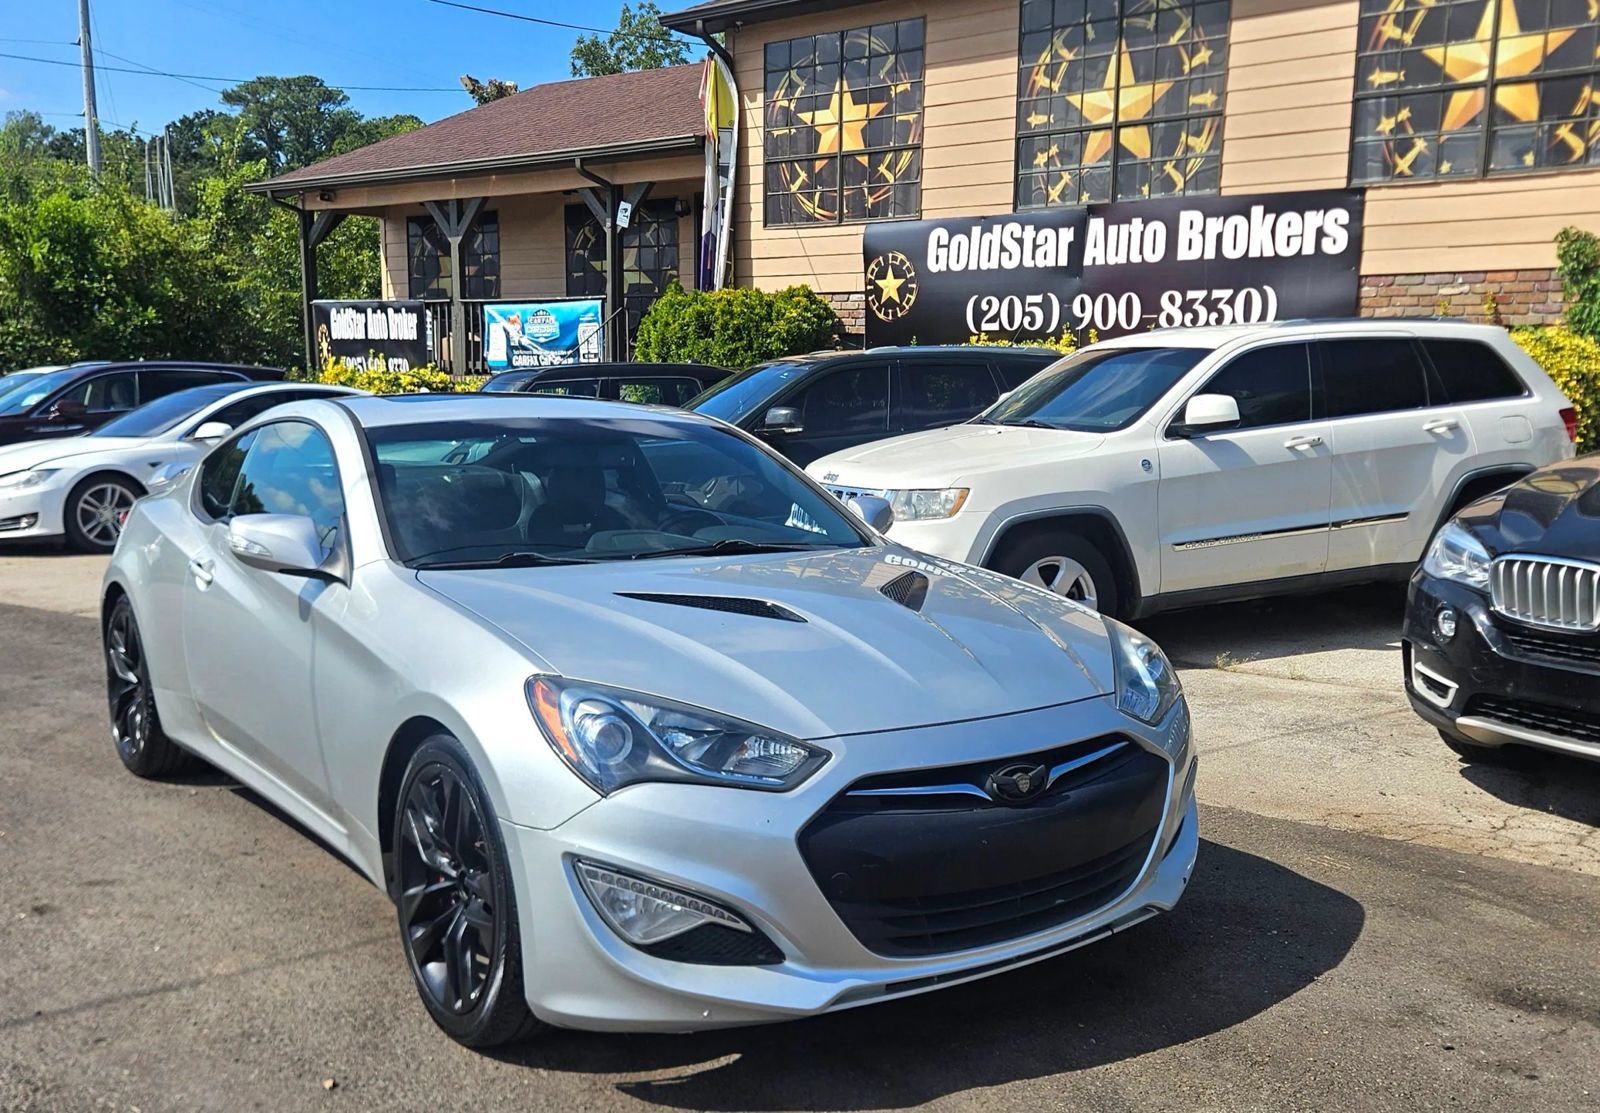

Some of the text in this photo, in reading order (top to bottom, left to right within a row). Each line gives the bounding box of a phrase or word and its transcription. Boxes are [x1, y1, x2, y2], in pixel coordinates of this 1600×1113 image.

[927, 205, 1350, 273] GoldStar Auto Brokers
[367, 308, 388, 340] Auto
[966, 293, 1060, 334] (205)
